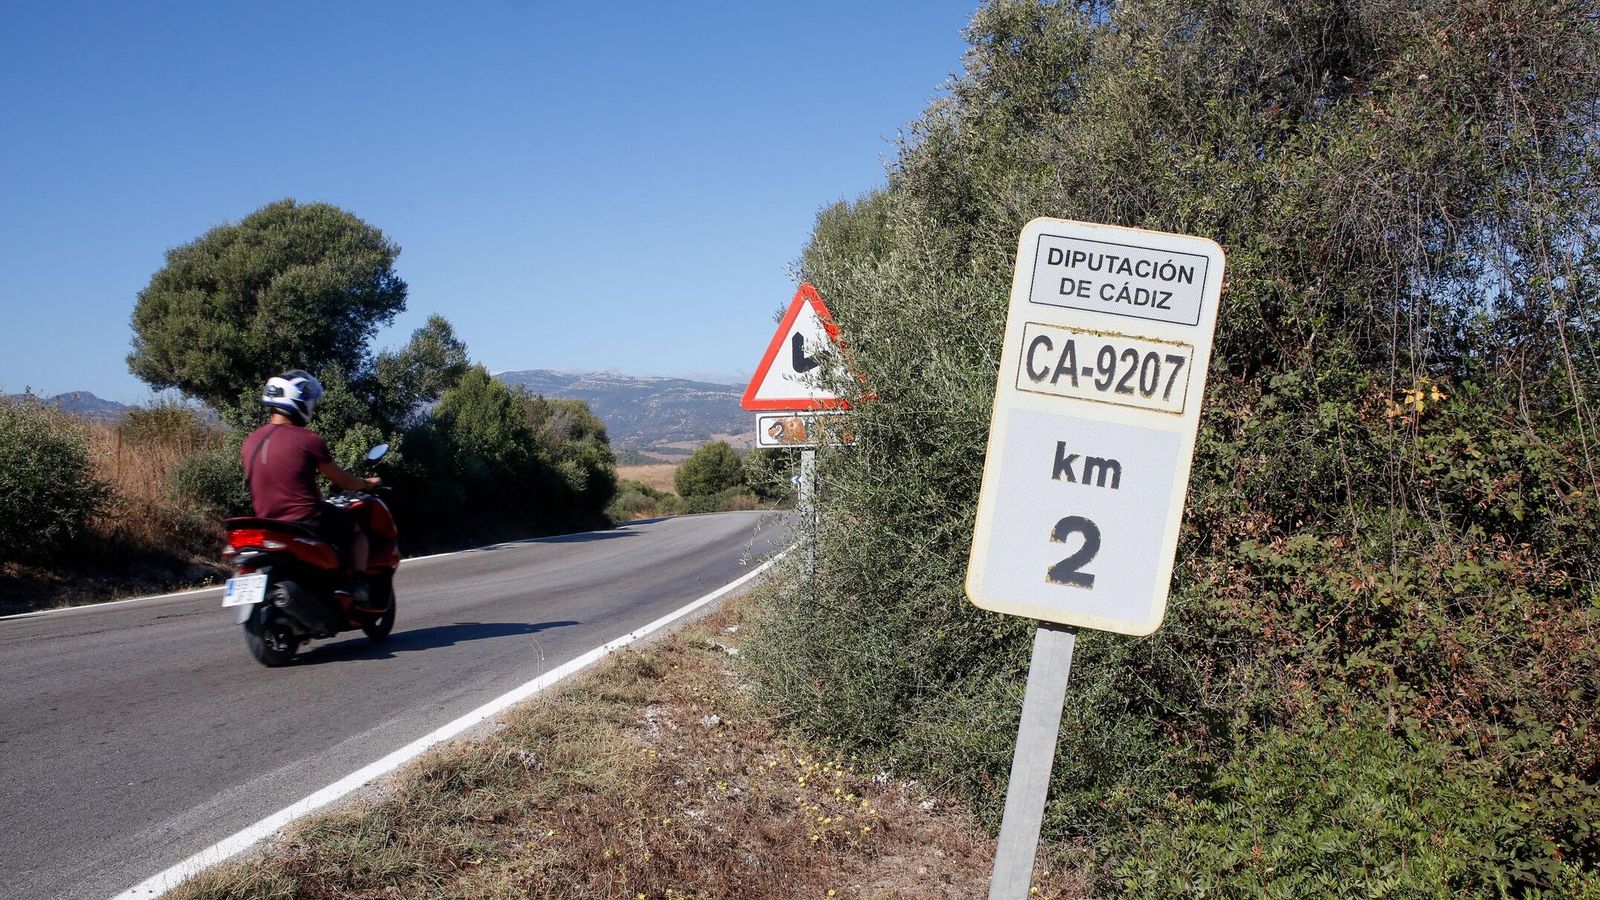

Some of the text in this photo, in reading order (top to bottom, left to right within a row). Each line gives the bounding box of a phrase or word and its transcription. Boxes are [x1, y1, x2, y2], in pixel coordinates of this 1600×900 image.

[1047, 247, 1194, 285] DIPUTACIÓN
[1059, 278, 1173, 310] DE CÁDIZ
[1026, 334, 1185, 402] CA-9207
[1051, 441, 1122, 490] km
[1045, 515, 1101, 590] 2
